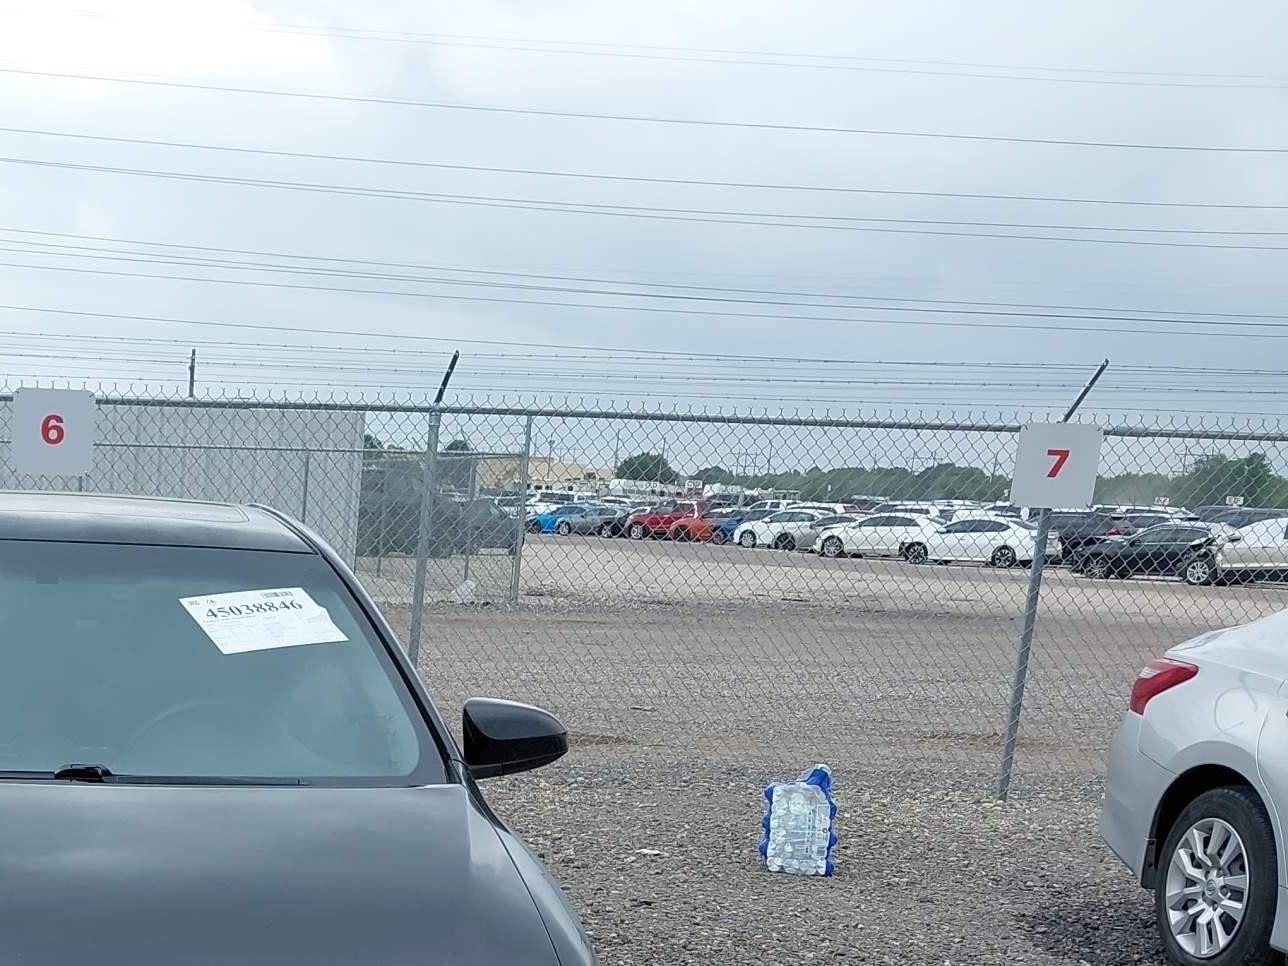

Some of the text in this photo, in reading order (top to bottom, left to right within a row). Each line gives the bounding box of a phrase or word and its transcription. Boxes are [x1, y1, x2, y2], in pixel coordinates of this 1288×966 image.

[41, 414, 65, 445] 6
[1047, 449, 1070, 478] 7
[206, 599, 303, 619] 45038846
